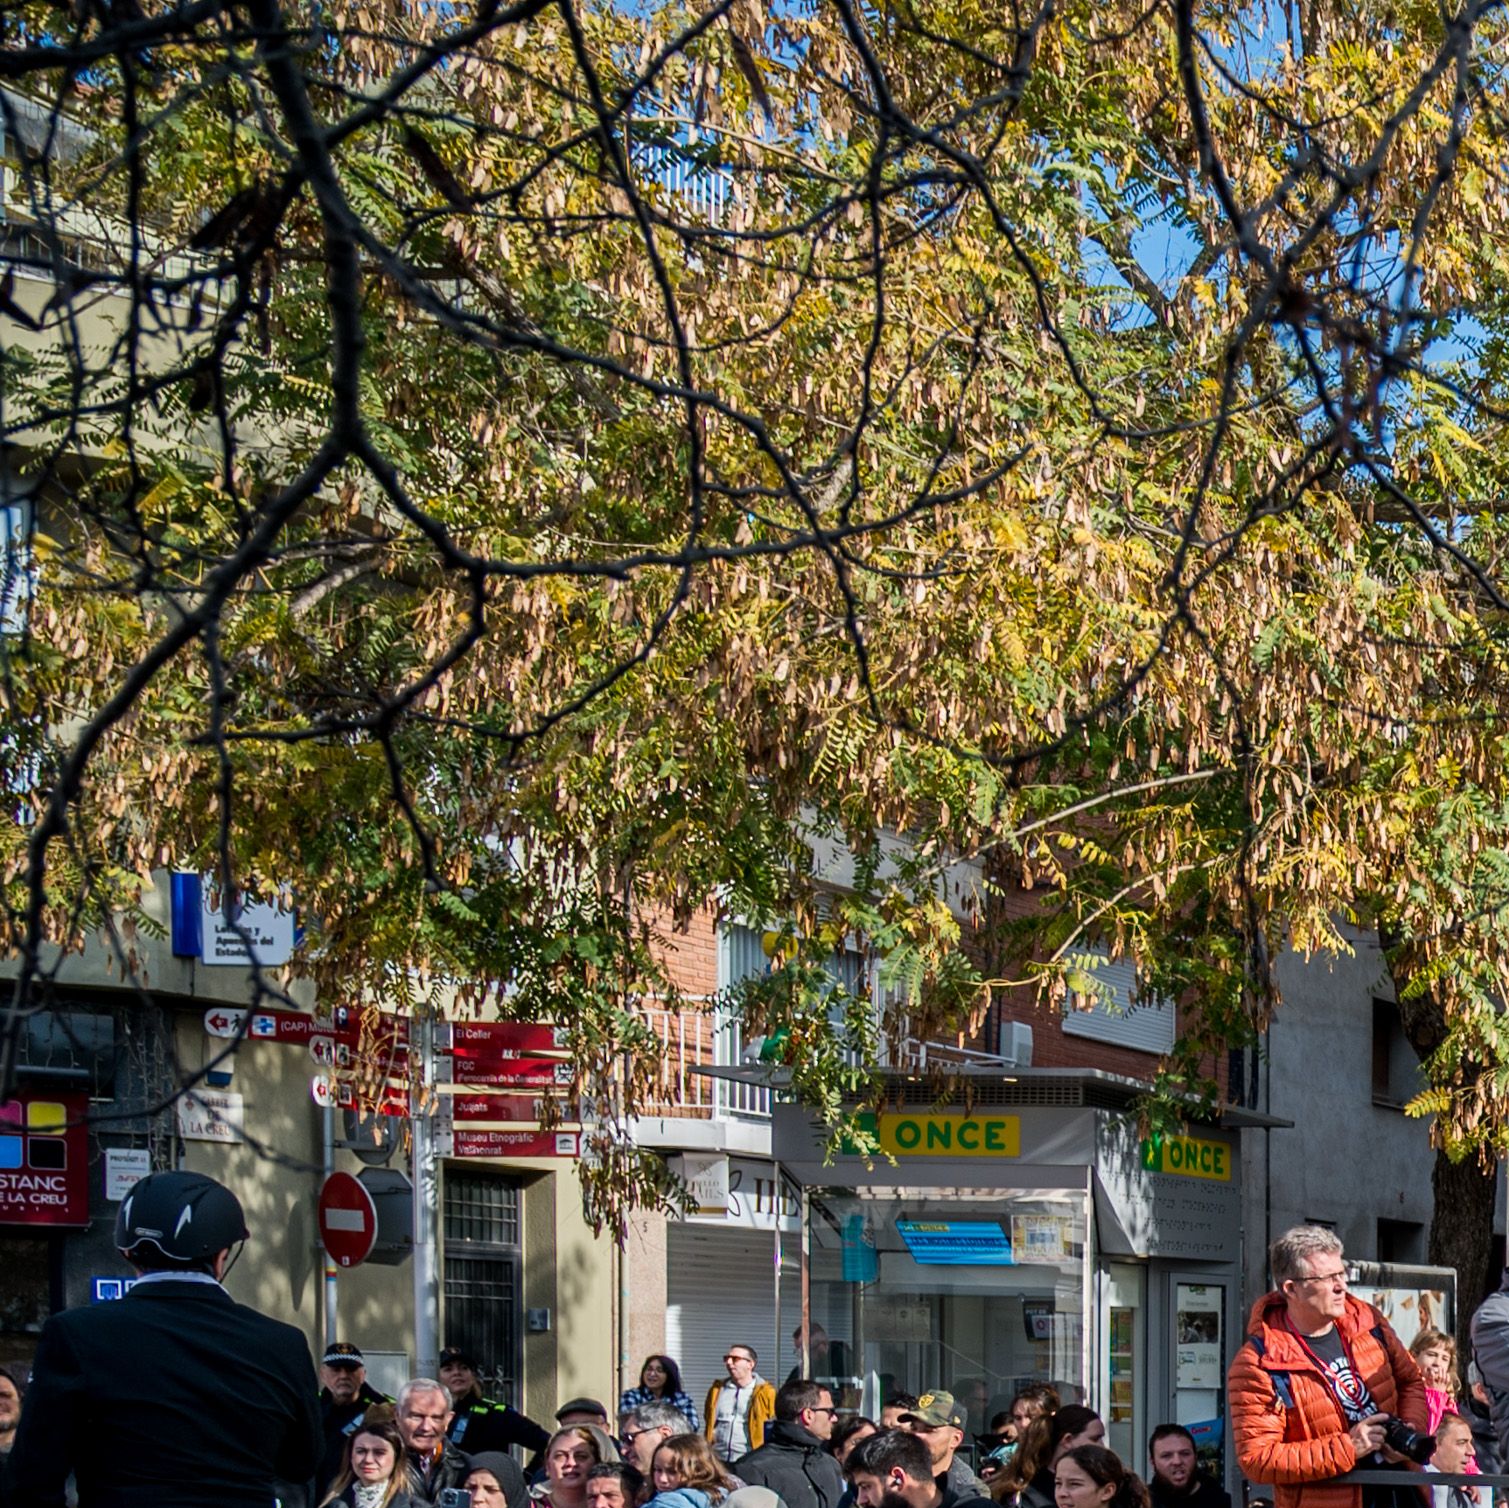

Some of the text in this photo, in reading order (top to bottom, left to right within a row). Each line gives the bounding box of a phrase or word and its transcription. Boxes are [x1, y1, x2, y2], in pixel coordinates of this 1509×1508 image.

[260, 936, 274, 946] del
[281, 1020, 307, 1033] (CAP)
[466, 1029, 491, 1040] Celler
[457, 1061, 475, 1071] FGC
[190, 1120, 203, 1134] LA
[458, 1132, 487, 1143] Museu
[895, 1120, 1006, 1150] ONCE
[1169, 1141, 1225, 1174] ONCE
[8, 1192, 26, 1204] LA
[29, 1193, 68, 1206] CREU
